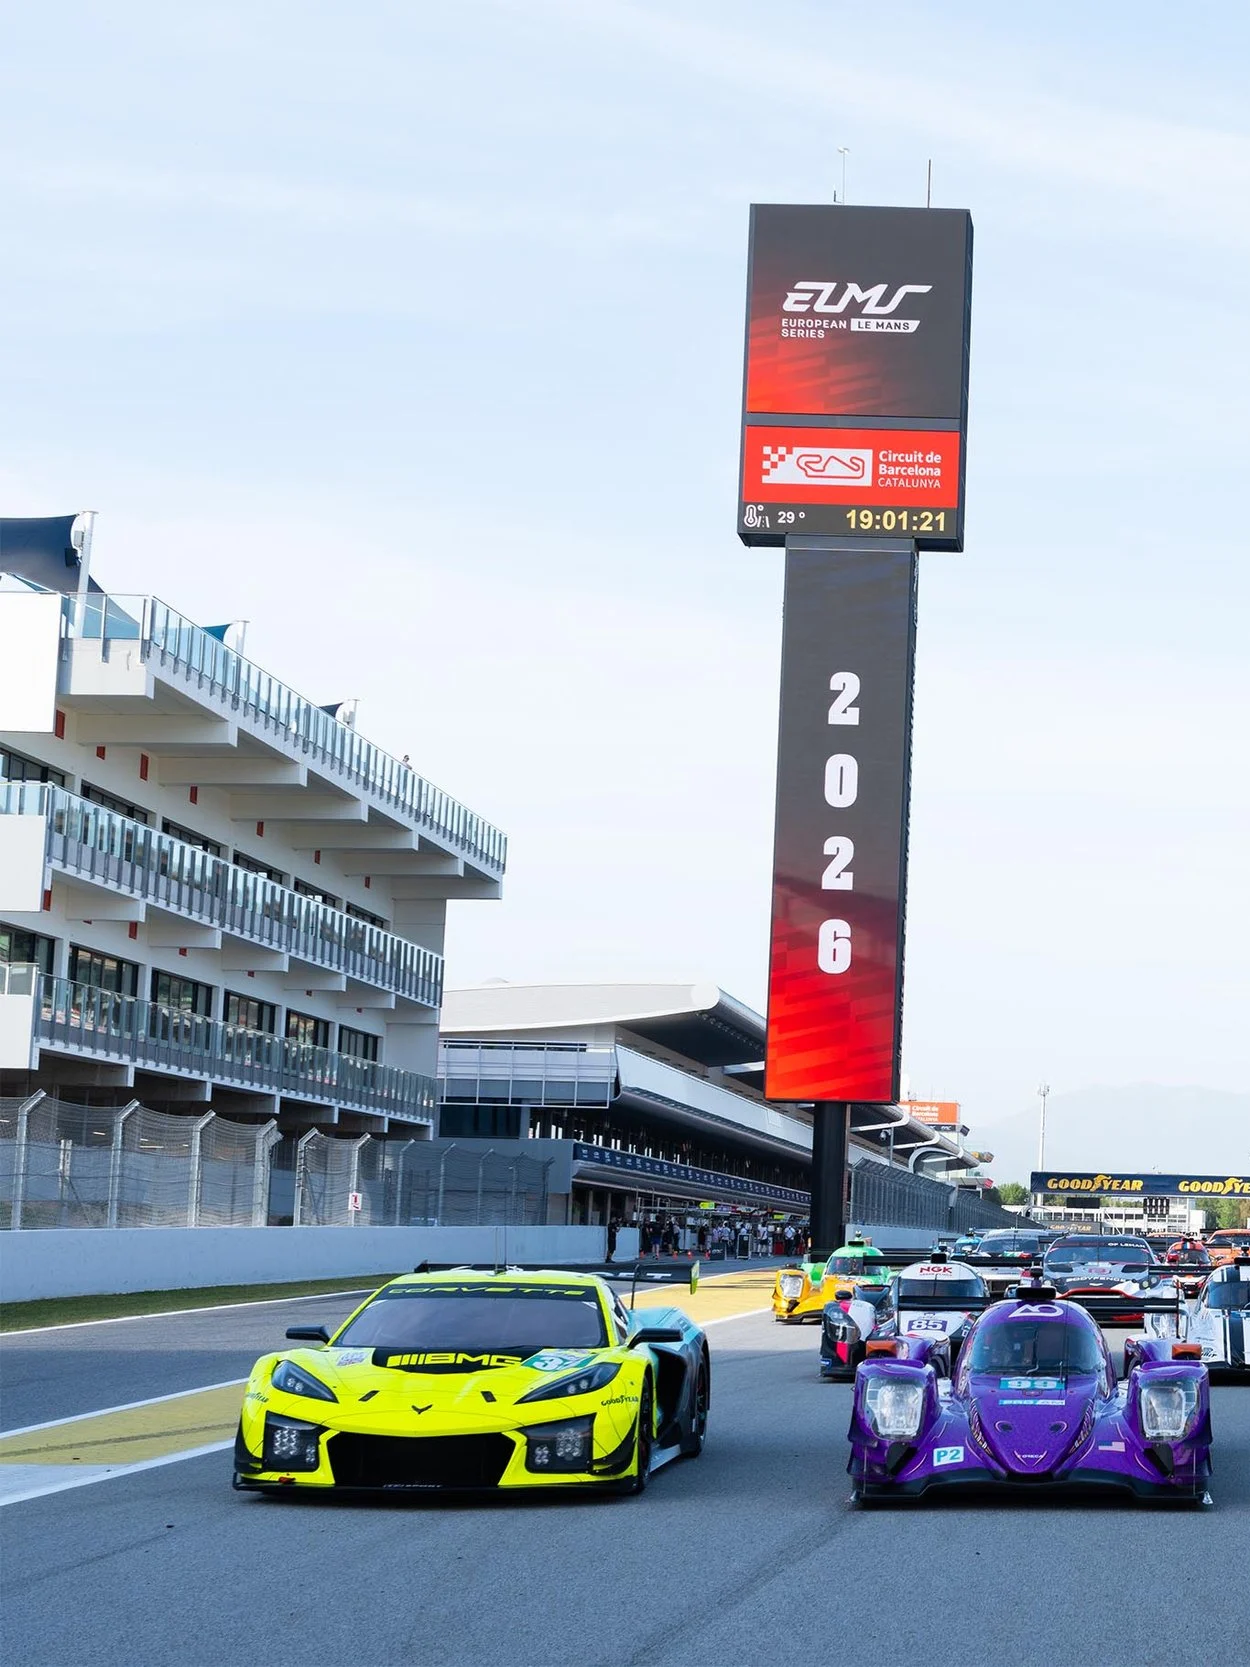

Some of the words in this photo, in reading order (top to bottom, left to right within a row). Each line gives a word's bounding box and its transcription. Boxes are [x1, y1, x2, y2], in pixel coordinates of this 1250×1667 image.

[782, 281, 934, 315] ELMS
[781, 318, 847, 330] EUROPEAN
[857, 320, 873, 330] LE
[875, 321, 911, 332] MANS
[781, 328, 825, 338] SERIES
[879, 450, 923, 463] Circuit
[925, 451, 942, 463] de
[878, 463, 942, 477] Barcelona
[878, 477, 941, 489] CATALUNYA
[777, 511, 796, 524] 29
[846, 509, 946, 532] 19:01:21
[1047, 1175, 1144, 1192] GOODYEAR
[919, 1266, 953, 1274] NGK
[388, 1287, 586, 1296] CORVETTE
[911, 1320, 943, 1330] 85
[1007, 1379, 1057, 1389] 99
[936, 1449, 961, 1463] P2
